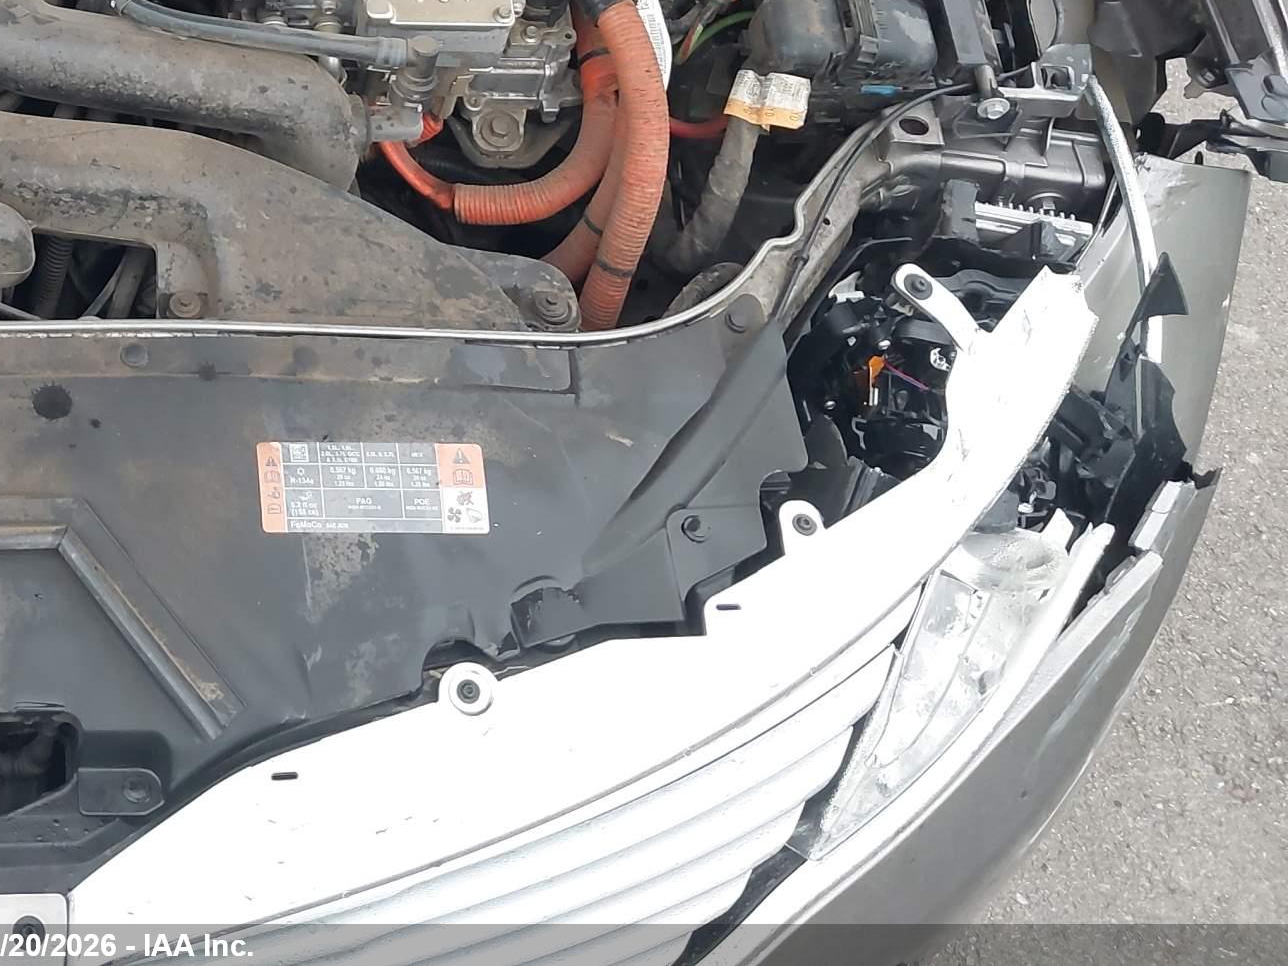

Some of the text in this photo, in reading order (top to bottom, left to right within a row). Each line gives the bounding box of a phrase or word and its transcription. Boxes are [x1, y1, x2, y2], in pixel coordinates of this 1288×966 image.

[289, 476, 314, 485] R-134a
[355, 497, 372, 505] PAG
[413, 497, 432, 505] POE
